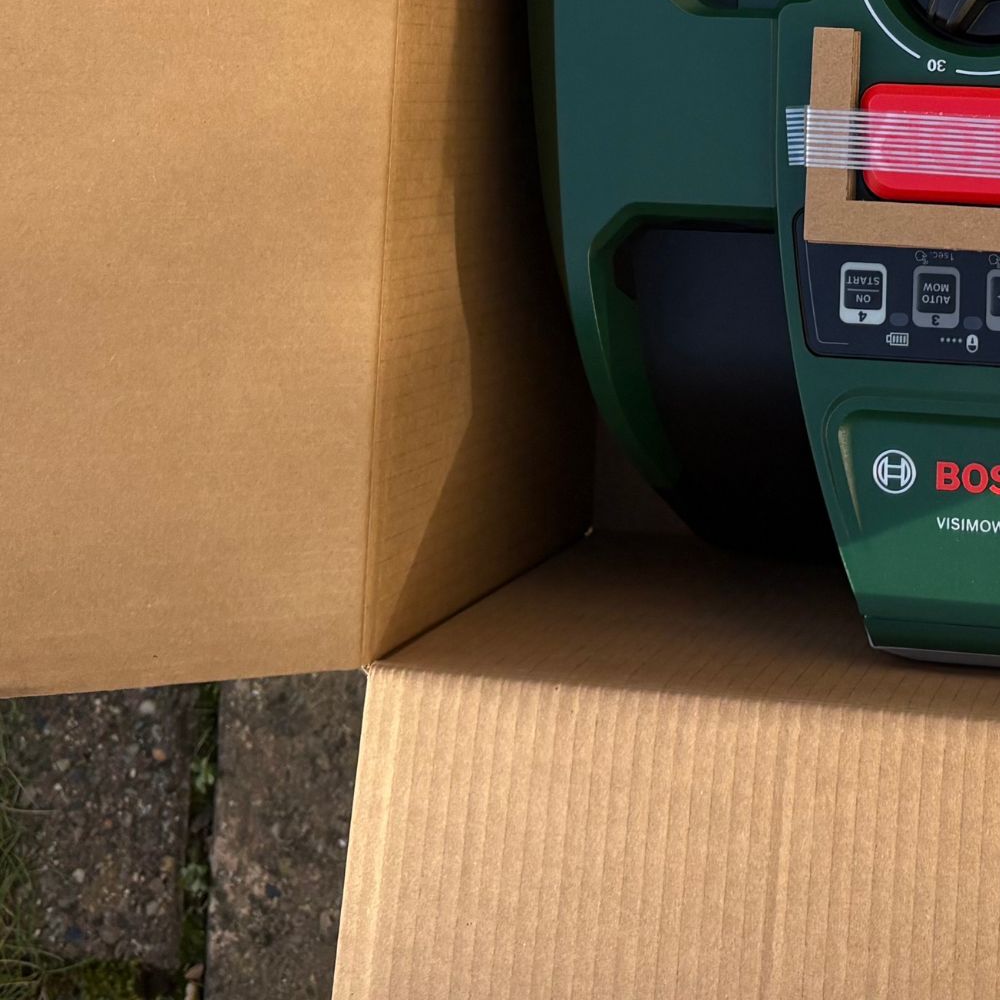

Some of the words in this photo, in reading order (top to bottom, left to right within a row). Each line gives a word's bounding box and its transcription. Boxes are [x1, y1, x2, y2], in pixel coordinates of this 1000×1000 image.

[927, 59, 946, 72] 30
[845, 275, 880, 286] START
[922, 282, 949, 293] MOW
[856, 294, 871, 304] ON
[922, 293, 951, 304] AUTO
[858, 311, 868, 322] 4
[931, 315, 940, 326] 3
